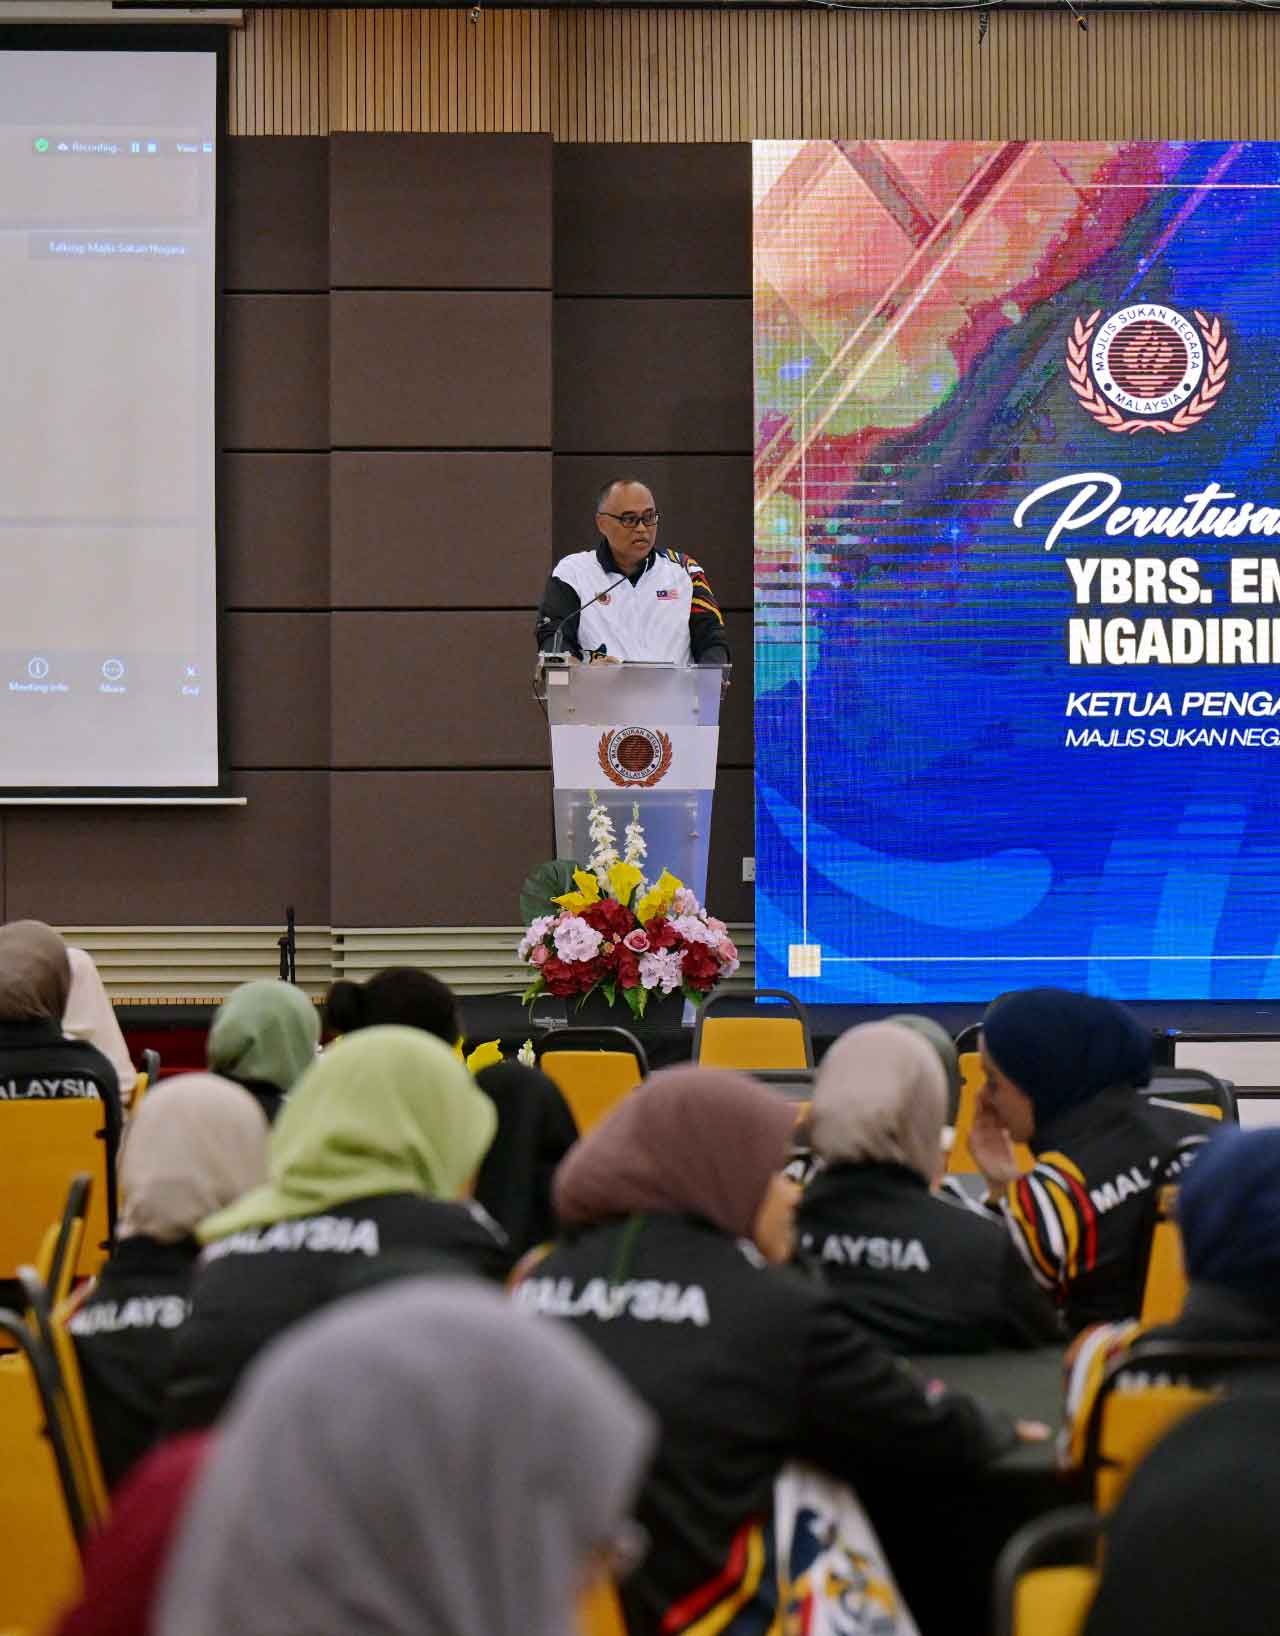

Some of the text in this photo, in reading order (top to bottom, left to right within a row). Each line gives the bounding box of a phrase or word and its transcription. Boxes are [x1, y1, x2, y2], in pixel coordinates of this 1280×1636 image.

[1095, 308, 1200, 371] MAJLIS SUKAN NEGARA
[1115, 393, 1182, 412] MALAYSIA
[1066, 557, 1213, 604] YBRS.
[1066, 692, 1173, 717] KETUA
[1066, 728, 1145, 747] MAJLIS
[1148, 728, 1228, 747] SUKAN
